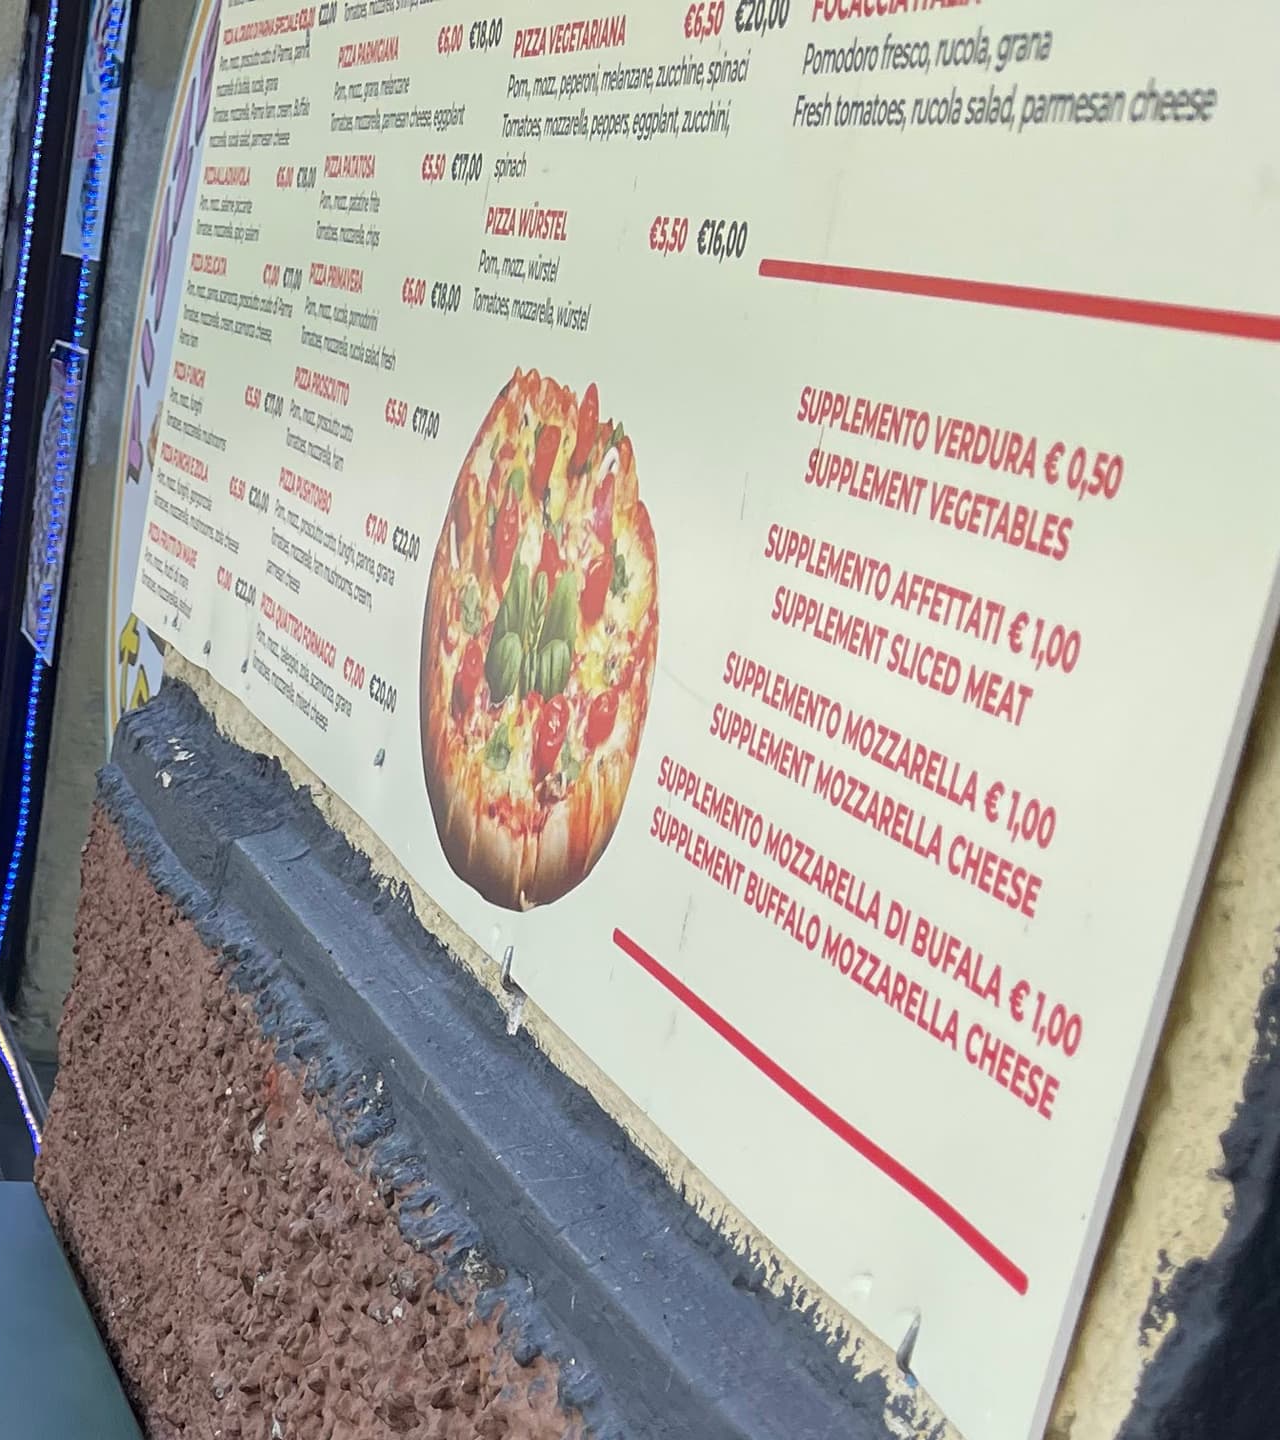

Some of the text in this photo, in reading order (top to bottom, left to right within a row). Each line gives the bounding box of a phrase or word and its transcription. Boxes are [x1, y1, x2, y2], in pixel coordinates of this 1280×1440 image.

[437, 23, 464, 56] €6,00
[468, 17, 503, 52] €18,00
[512, 0, 790, 59] PIZZA VEGETARIANA €6,50 €20,00
[802, 26, 1053, 75] Pomodoro fresco, rucola, grana
[558, 63, 601, 101] peperoni,
[600, 62, 654, 92] melanzane,
[655, 54, 705, 89] zucchine,
[706, 48, 751, 91] spinaci
[501, 99, 731, 142] Tomatoes, mozzarella, peppers, eggplant, zucchini,
[792, 79, 1217, 132] Fresh tomatoes, rucola salad, parmesan cheese
[421, 152, 446, 184] €5,50
[450, 152, 483, 185] €17,00
[493, 151, 527, 183] spinach
[484, 201, 748, 263] PIZZA WÜRSTEL €5,50 €16,00
[527, 253, 561, 283] würstel
[401, 276, 427, 308] €6,00
[430, 281, 462, 315] €18,00
[472, 286, 592, 331] Tomatoes, mozzarella, würstel
[384, 397, 408, 428] €5,50
[411, 405, 440, 440] €17,00
[797, 386, 1124, 500] SUPPLEMENTO VERDURA € 0,50
[804, 447, 1072, 560] SUPPLEMENT VEGETABLES
[364, 512, 388, 545] €7,00
[391, 525, 421, 562] €22,00
[764, 524, 1081, 673] SUPPLEMENTO AFFETTATI € 1,00
[771, 586, 1033, 725] SUPPLEMENT SLICED MEAT
[342, 655, 365, 690] €7,00
[368, 673, 397, 713] €20,00
[723, 651, 1056, 849] SUPPLEMENTO MOZZARELLA € 1,00
[709, 703, 1042, 917] SUPPLEMENT MOZZARELLA CHEESE
[657, 756, 1083, 1057] SUPPLEMENTO MOZZARELLA DI BUFALA € 1,00
[650, 806, 1059, 1119] SUPPLEMENT BUFFALO MOZZARELLA CHEESE
